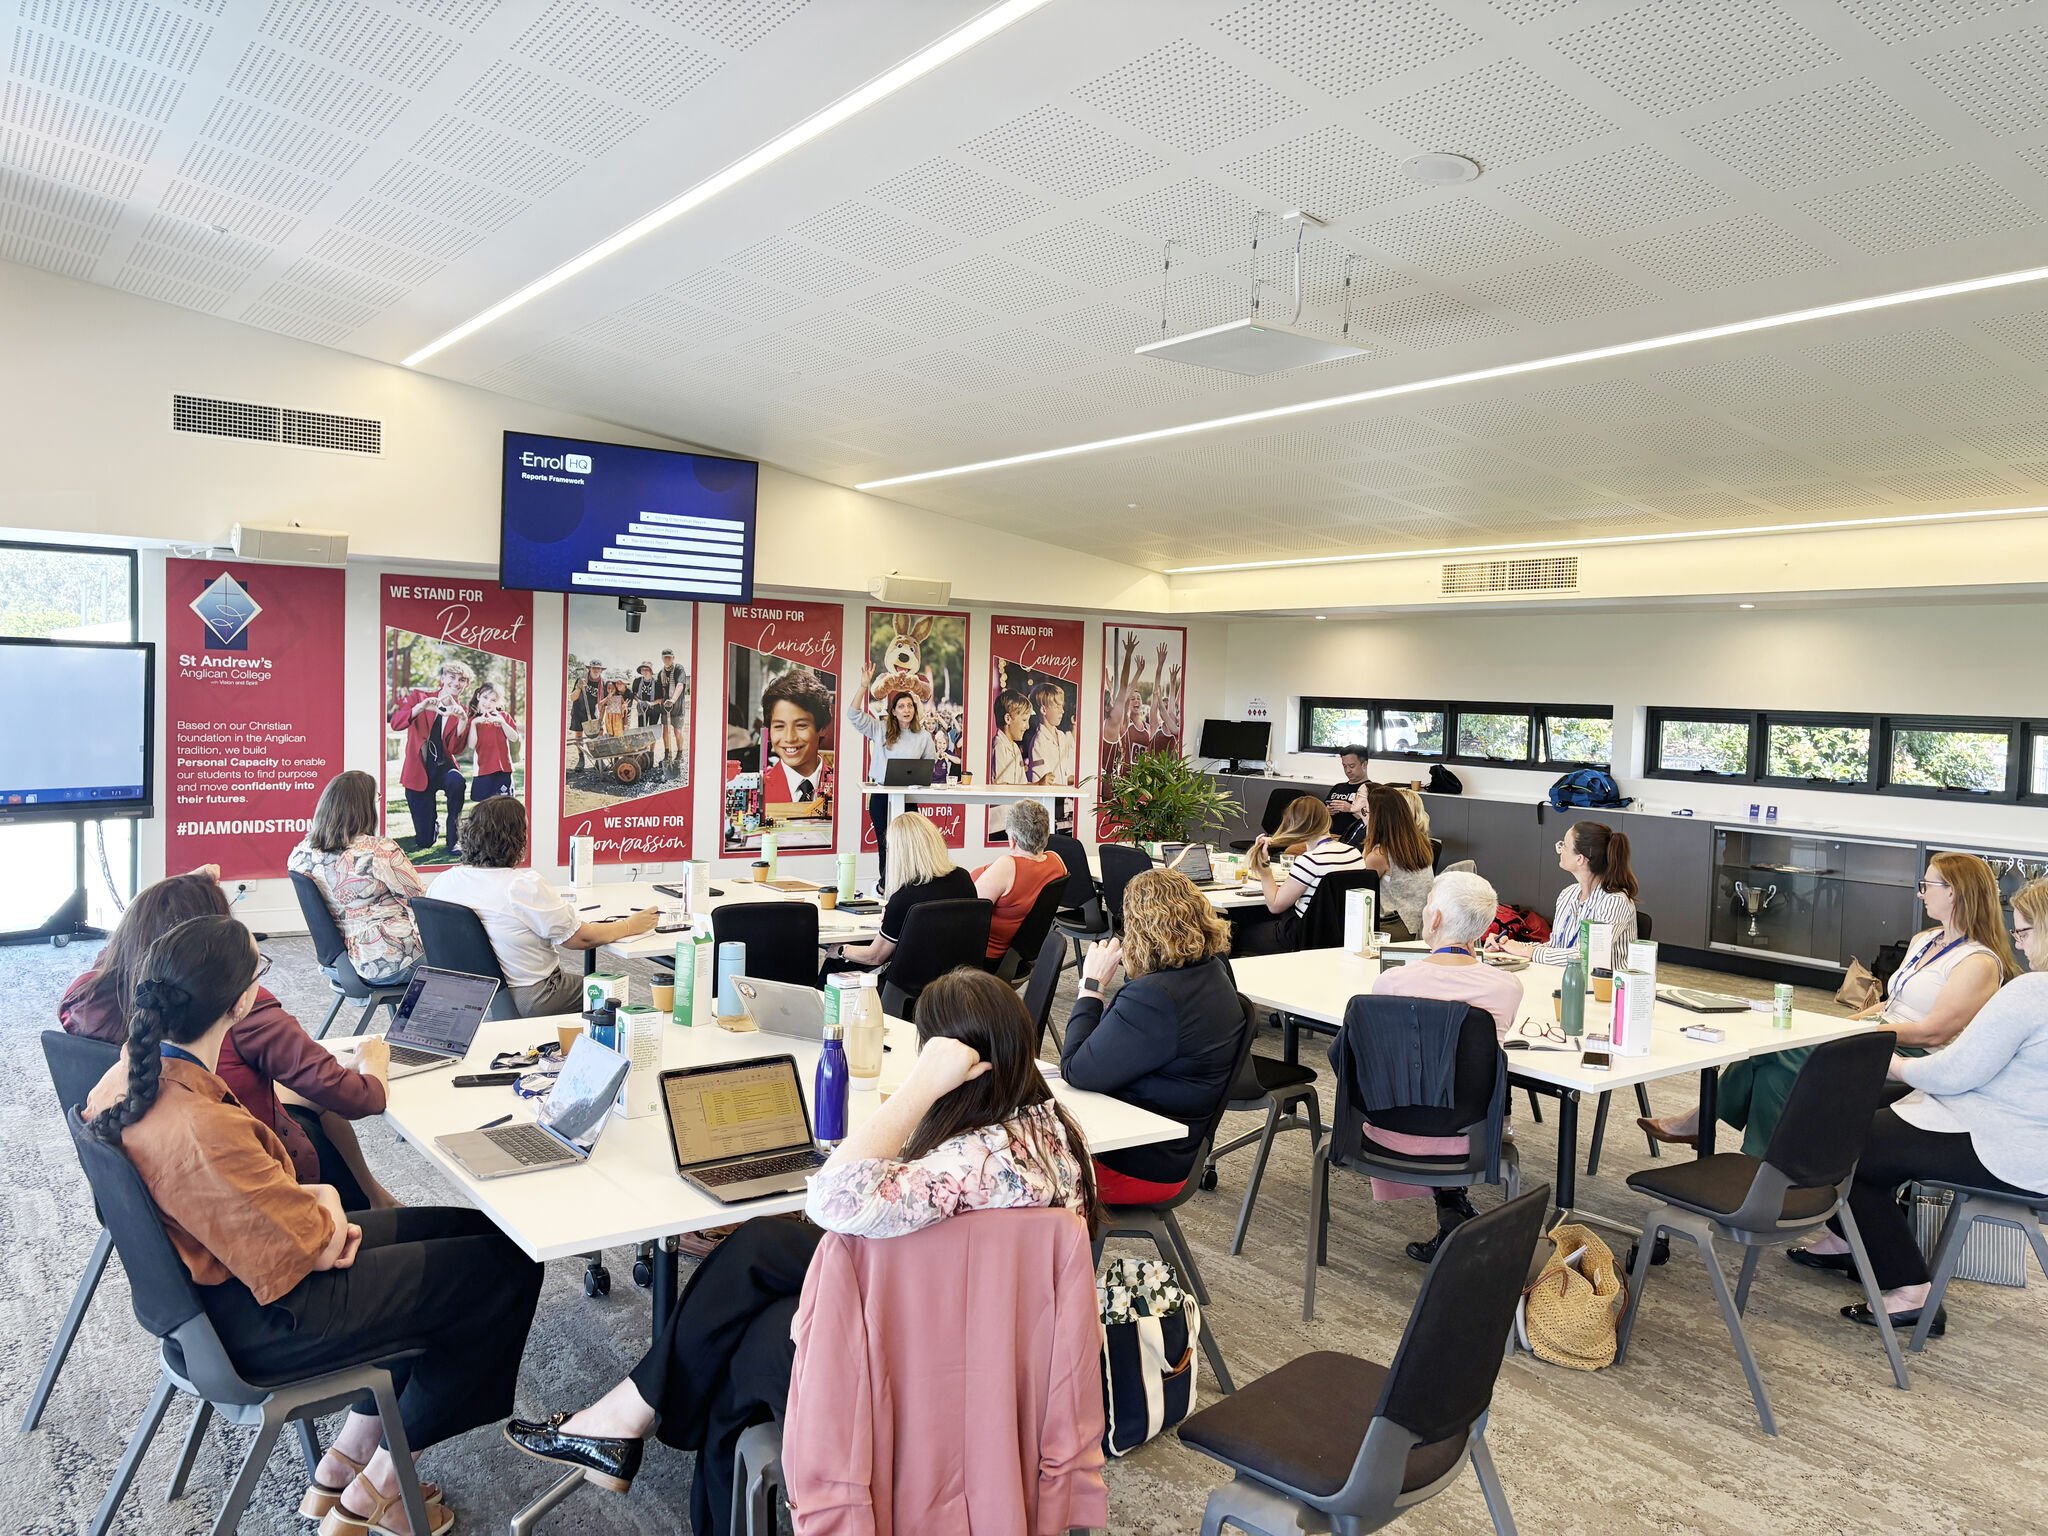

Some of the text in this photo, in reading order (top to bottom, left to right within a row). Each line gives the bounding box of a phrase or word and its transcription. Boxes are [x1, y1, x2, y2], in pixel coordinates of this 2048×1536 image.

[519, 451, 564, 470] Enrol
[522, 472, 584, 485] Reports Framework
[390, 585, 484, 602] WE STAND FOR
[732, 606, 805, 622] WE STAND FOR
[436, 604, 526, 650] Respect
[996, 624, 1054, 637] WE STAND FOR
[757, 623, 837, 668] Curiosity
[179, 654, 196, 667] St
[1020, 638, 1080, 680] Courage
[180, 668, 272, 682] Anglican College
[177, 721, 292, 731] Based on our Christian
[177, 734, 306, 744] foundation in the Anglican
[177, 746, 222, 756] tradition,
[242, 746, 267, 755] build
[177, 757, 326, 768] Personal Capacity to enable
[197, 770, 241, 779] students
[244, 770, 254, 778] to
[257, 769, 275, 778] find
[278, 770, 318, 780] purpose
[176, 781, 315, 793] and move confidently into
[176, 794, 248, 804] their futures.
[936, 806, 952, 817] FOR
[176, 818, 314, 836] #DIAMONDSTRON
[604, 816, 684, 828] WE STAND FOR
